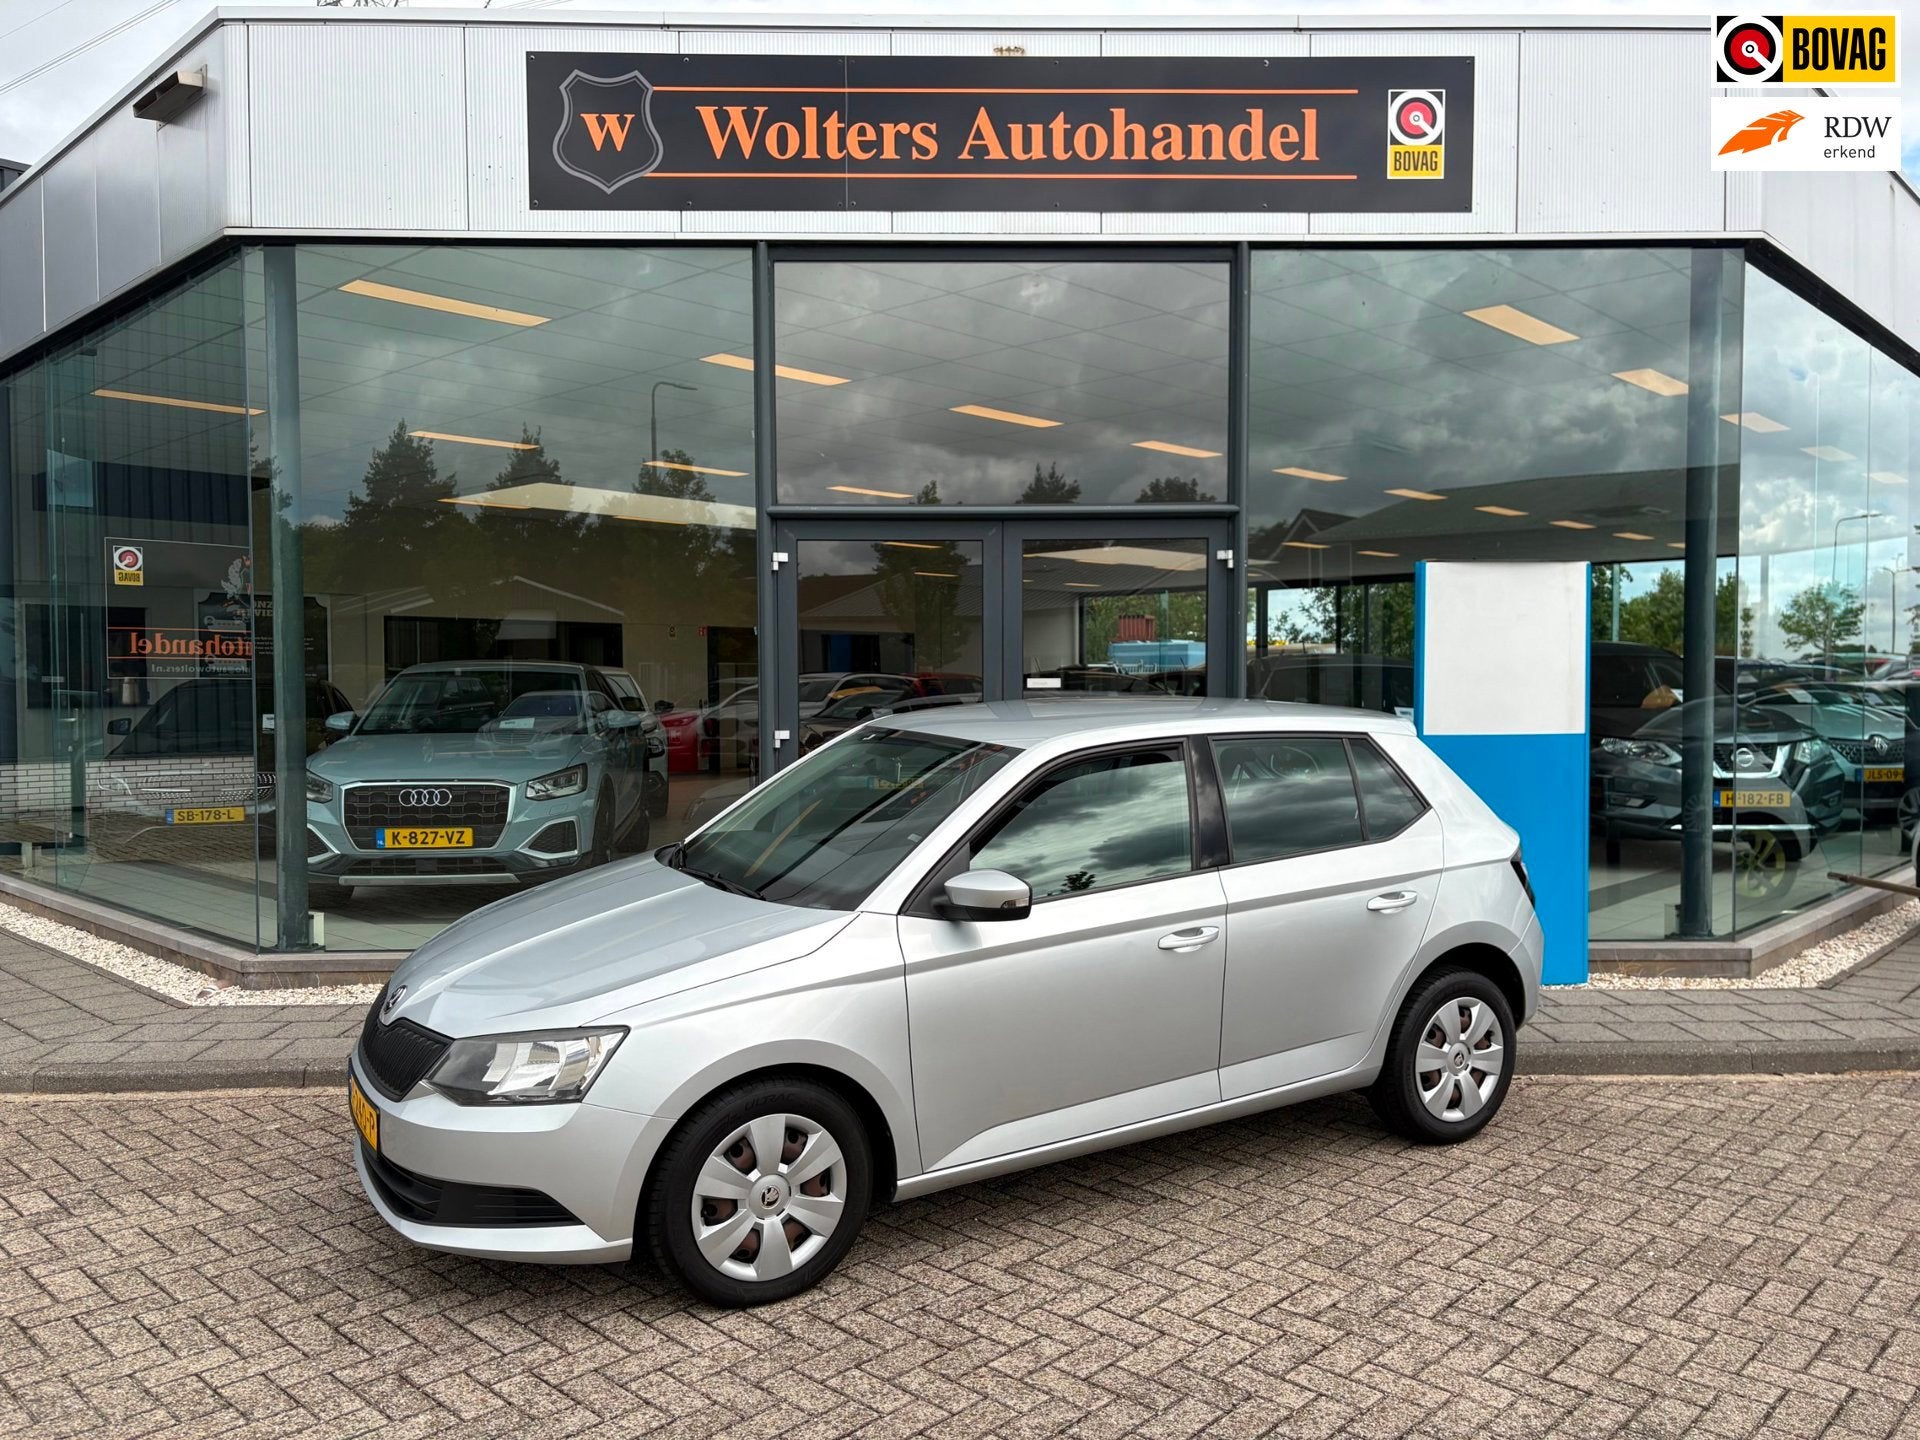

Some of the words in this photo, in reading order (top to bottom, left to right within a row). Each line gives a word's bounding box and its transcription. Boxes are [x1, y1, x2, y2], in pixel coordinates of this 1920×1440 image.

[580, 114, 635, 151] W
[695, 106, 938, 160] Wolters
[957, 106, 1320, 161] Autohandel
[1393, 151, 1438, 172] BOVAG
[178, 809, 234, 821] SB-178-L
[392, 831, 465, 845] K-827-VZ
